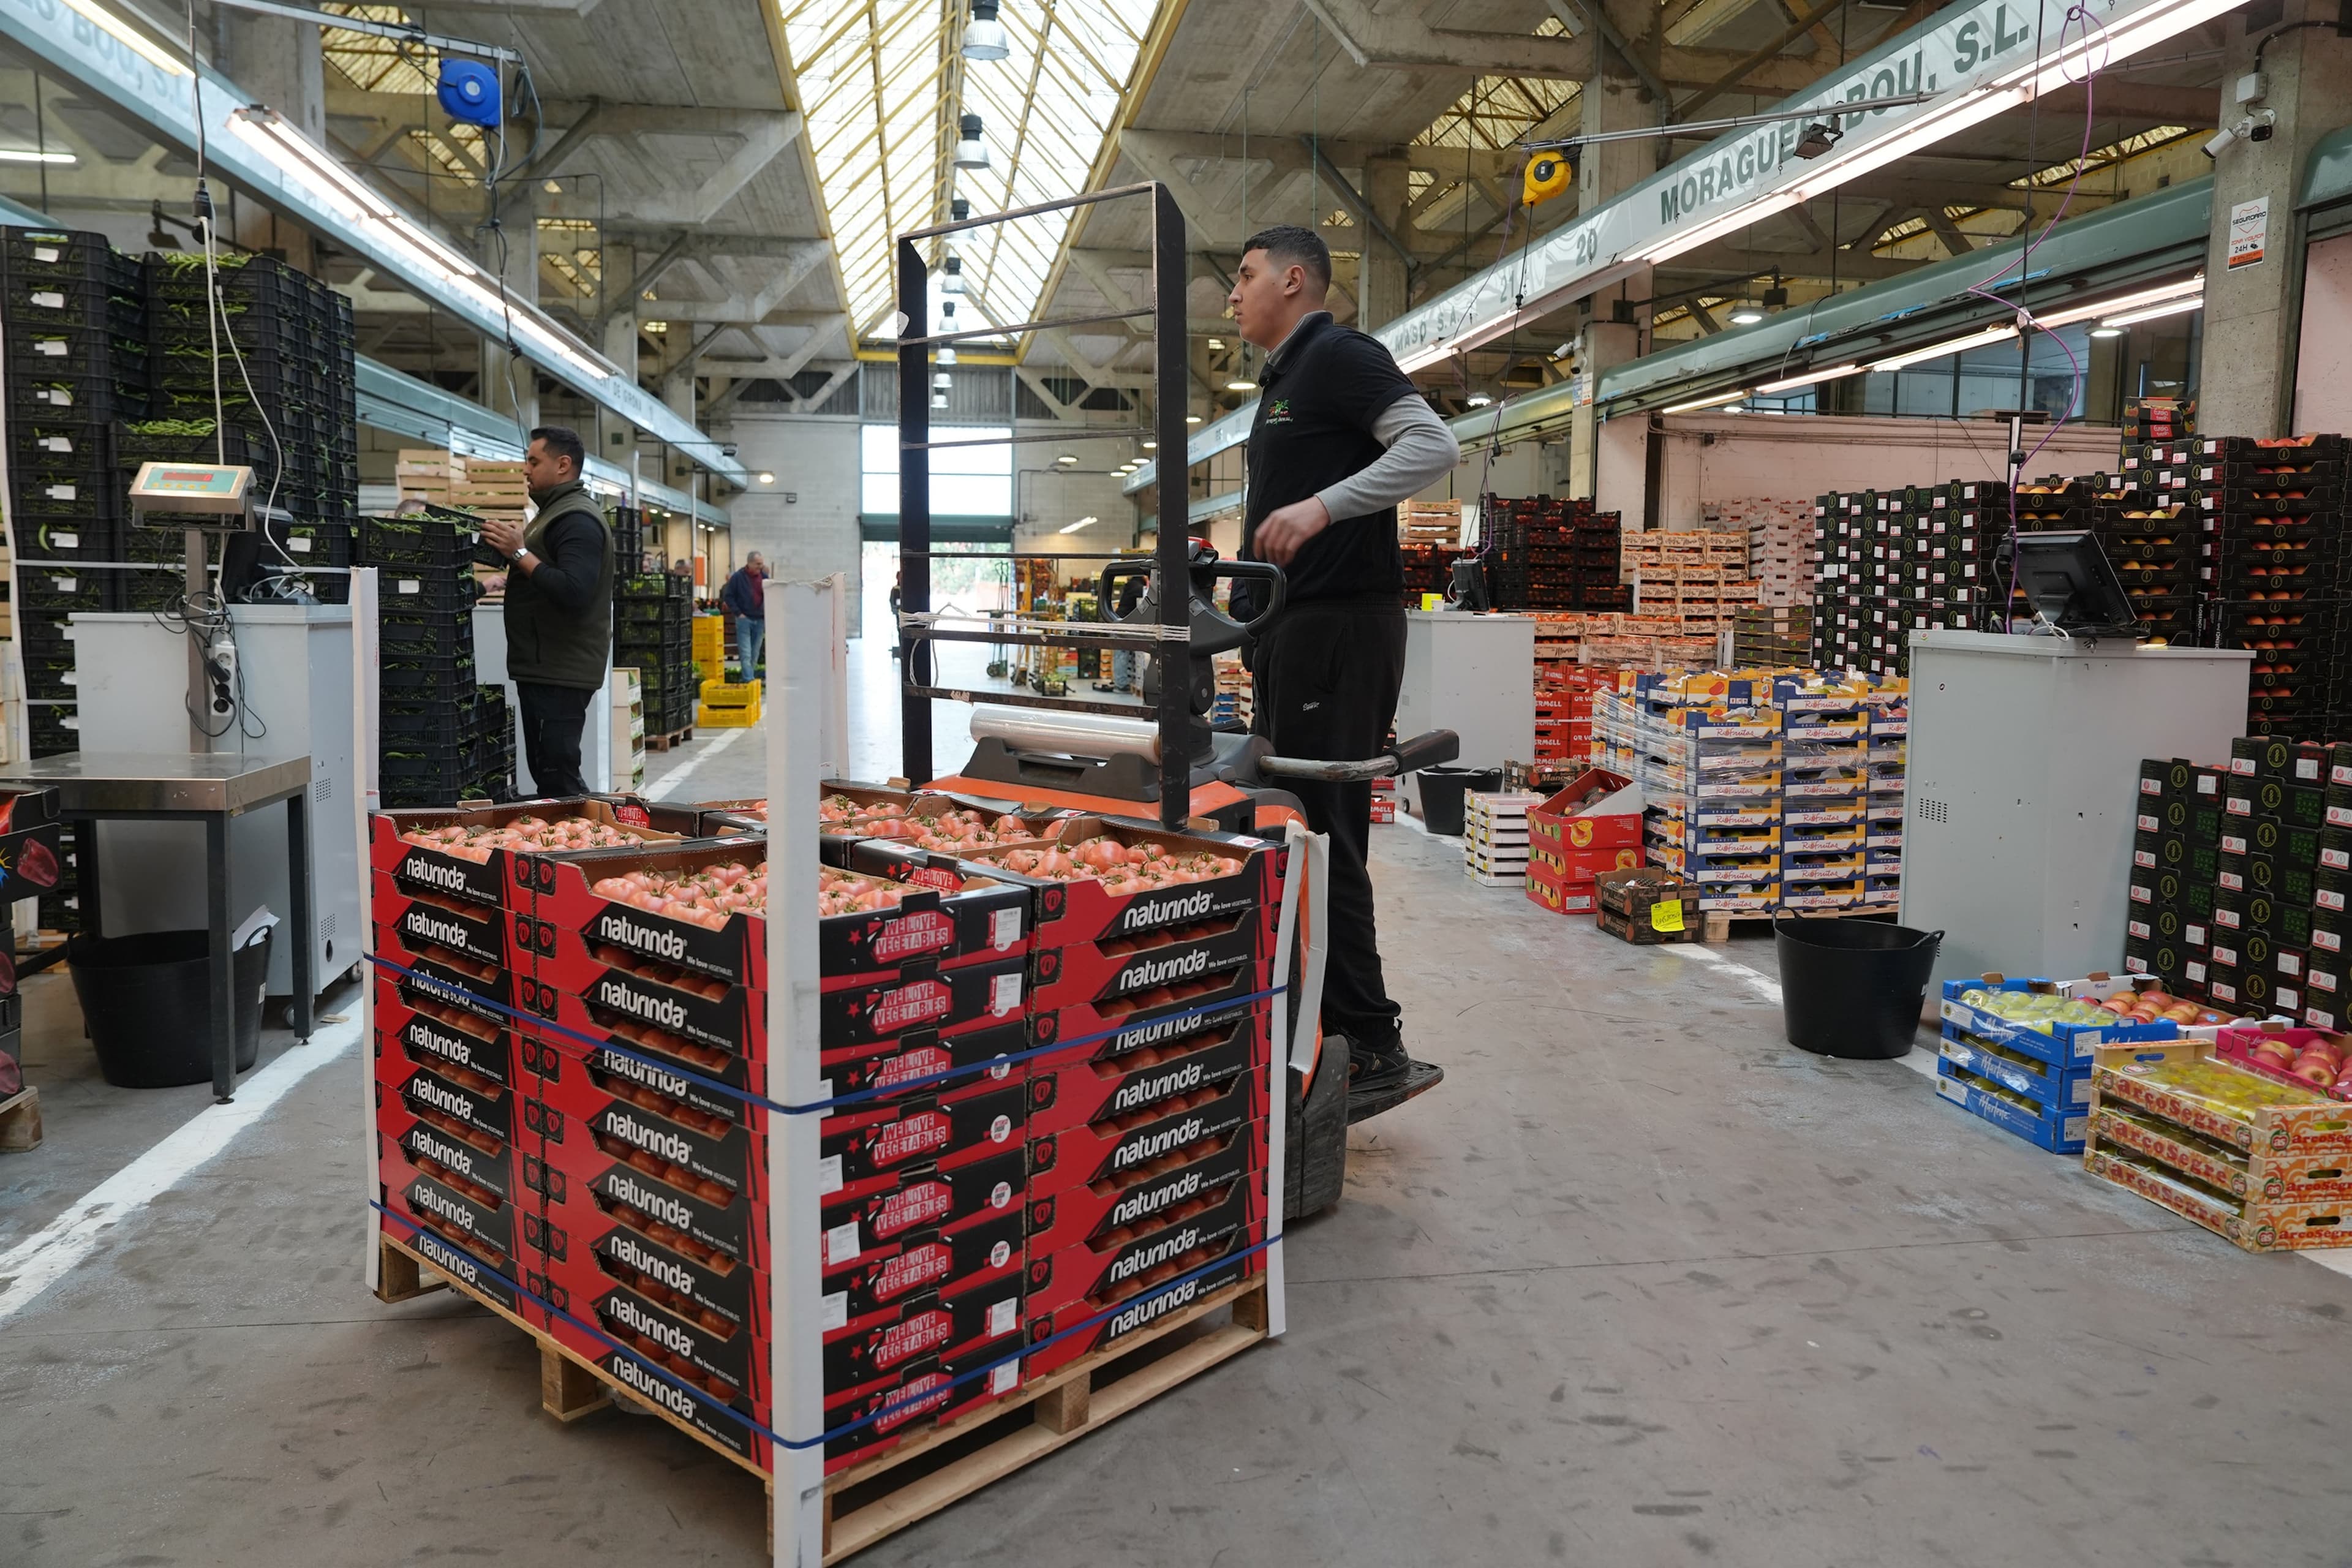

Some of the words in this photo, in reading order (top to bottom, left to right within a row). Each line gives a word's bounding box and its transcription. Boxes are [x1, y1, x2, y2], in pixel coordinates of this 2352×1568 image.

[1845, 50, 1936, 130] BOU,
[1954, 4, 2029, 74] S.L.
[1576, 228, 1597, 266] 20
[2234, 244, 2248, 254] 24H
[1500, 271, 1514, 303] 21
[913, 865, 930, 882] WE
[931, 870, 953, 888] LOVE
[1212, 903, 1222, 911] We
[885, 917, 905, 935] WE
[907, 912, 936, 930] LOVE
[876, 927, 948, 954] VEGETABLES
[686, 955, 695, 965] We
[696, 958, 707, 969] love
[1208, 960, 1217, 969] We
[883, 988, 903, 1006] WE
[905, 982, 934, 1001] LOVE
[874, 996, 946, 1025] VEGETABLES
[687, 1024, 695, 1034] We
[696, 1027, 708, 1039] love
[883, 1057, 903, 1077] WE
[905, 1048, 935, 1069] LOVE
[1203, 1072, 1212, 1081] We
[883, 1121, 903, 1140] WE
[904, 1114, 934, 1134] LOVE
[1202, 1126, 1210, 1135] We
[1210, 1123, 1220, 1133] love
[874, 1126, 946, 1159] VEGETABLES
[692, 1161, 701, 1170] We
[701, 1164, 713, 1176] love
[885, 1192, 905, 1211] WE
[905, 1183, 935, 1204] LOVE
[876, 1194, 947, 1231] VEGETABLES
[885, 1256, 905, 1275] WE
[905, 1244, 935, 1267] LOVE
[876, 1256, 947, 1294] VEGETABLES
[886, 1324, 905, 1343] WE
[906, 1312, 935, 1335] LOVE
[876, 1322, 948, 1363] VEGETABLES
[886, 1387, 905, 1408] WE
[906, 1374, 936, 1398] LOVE
